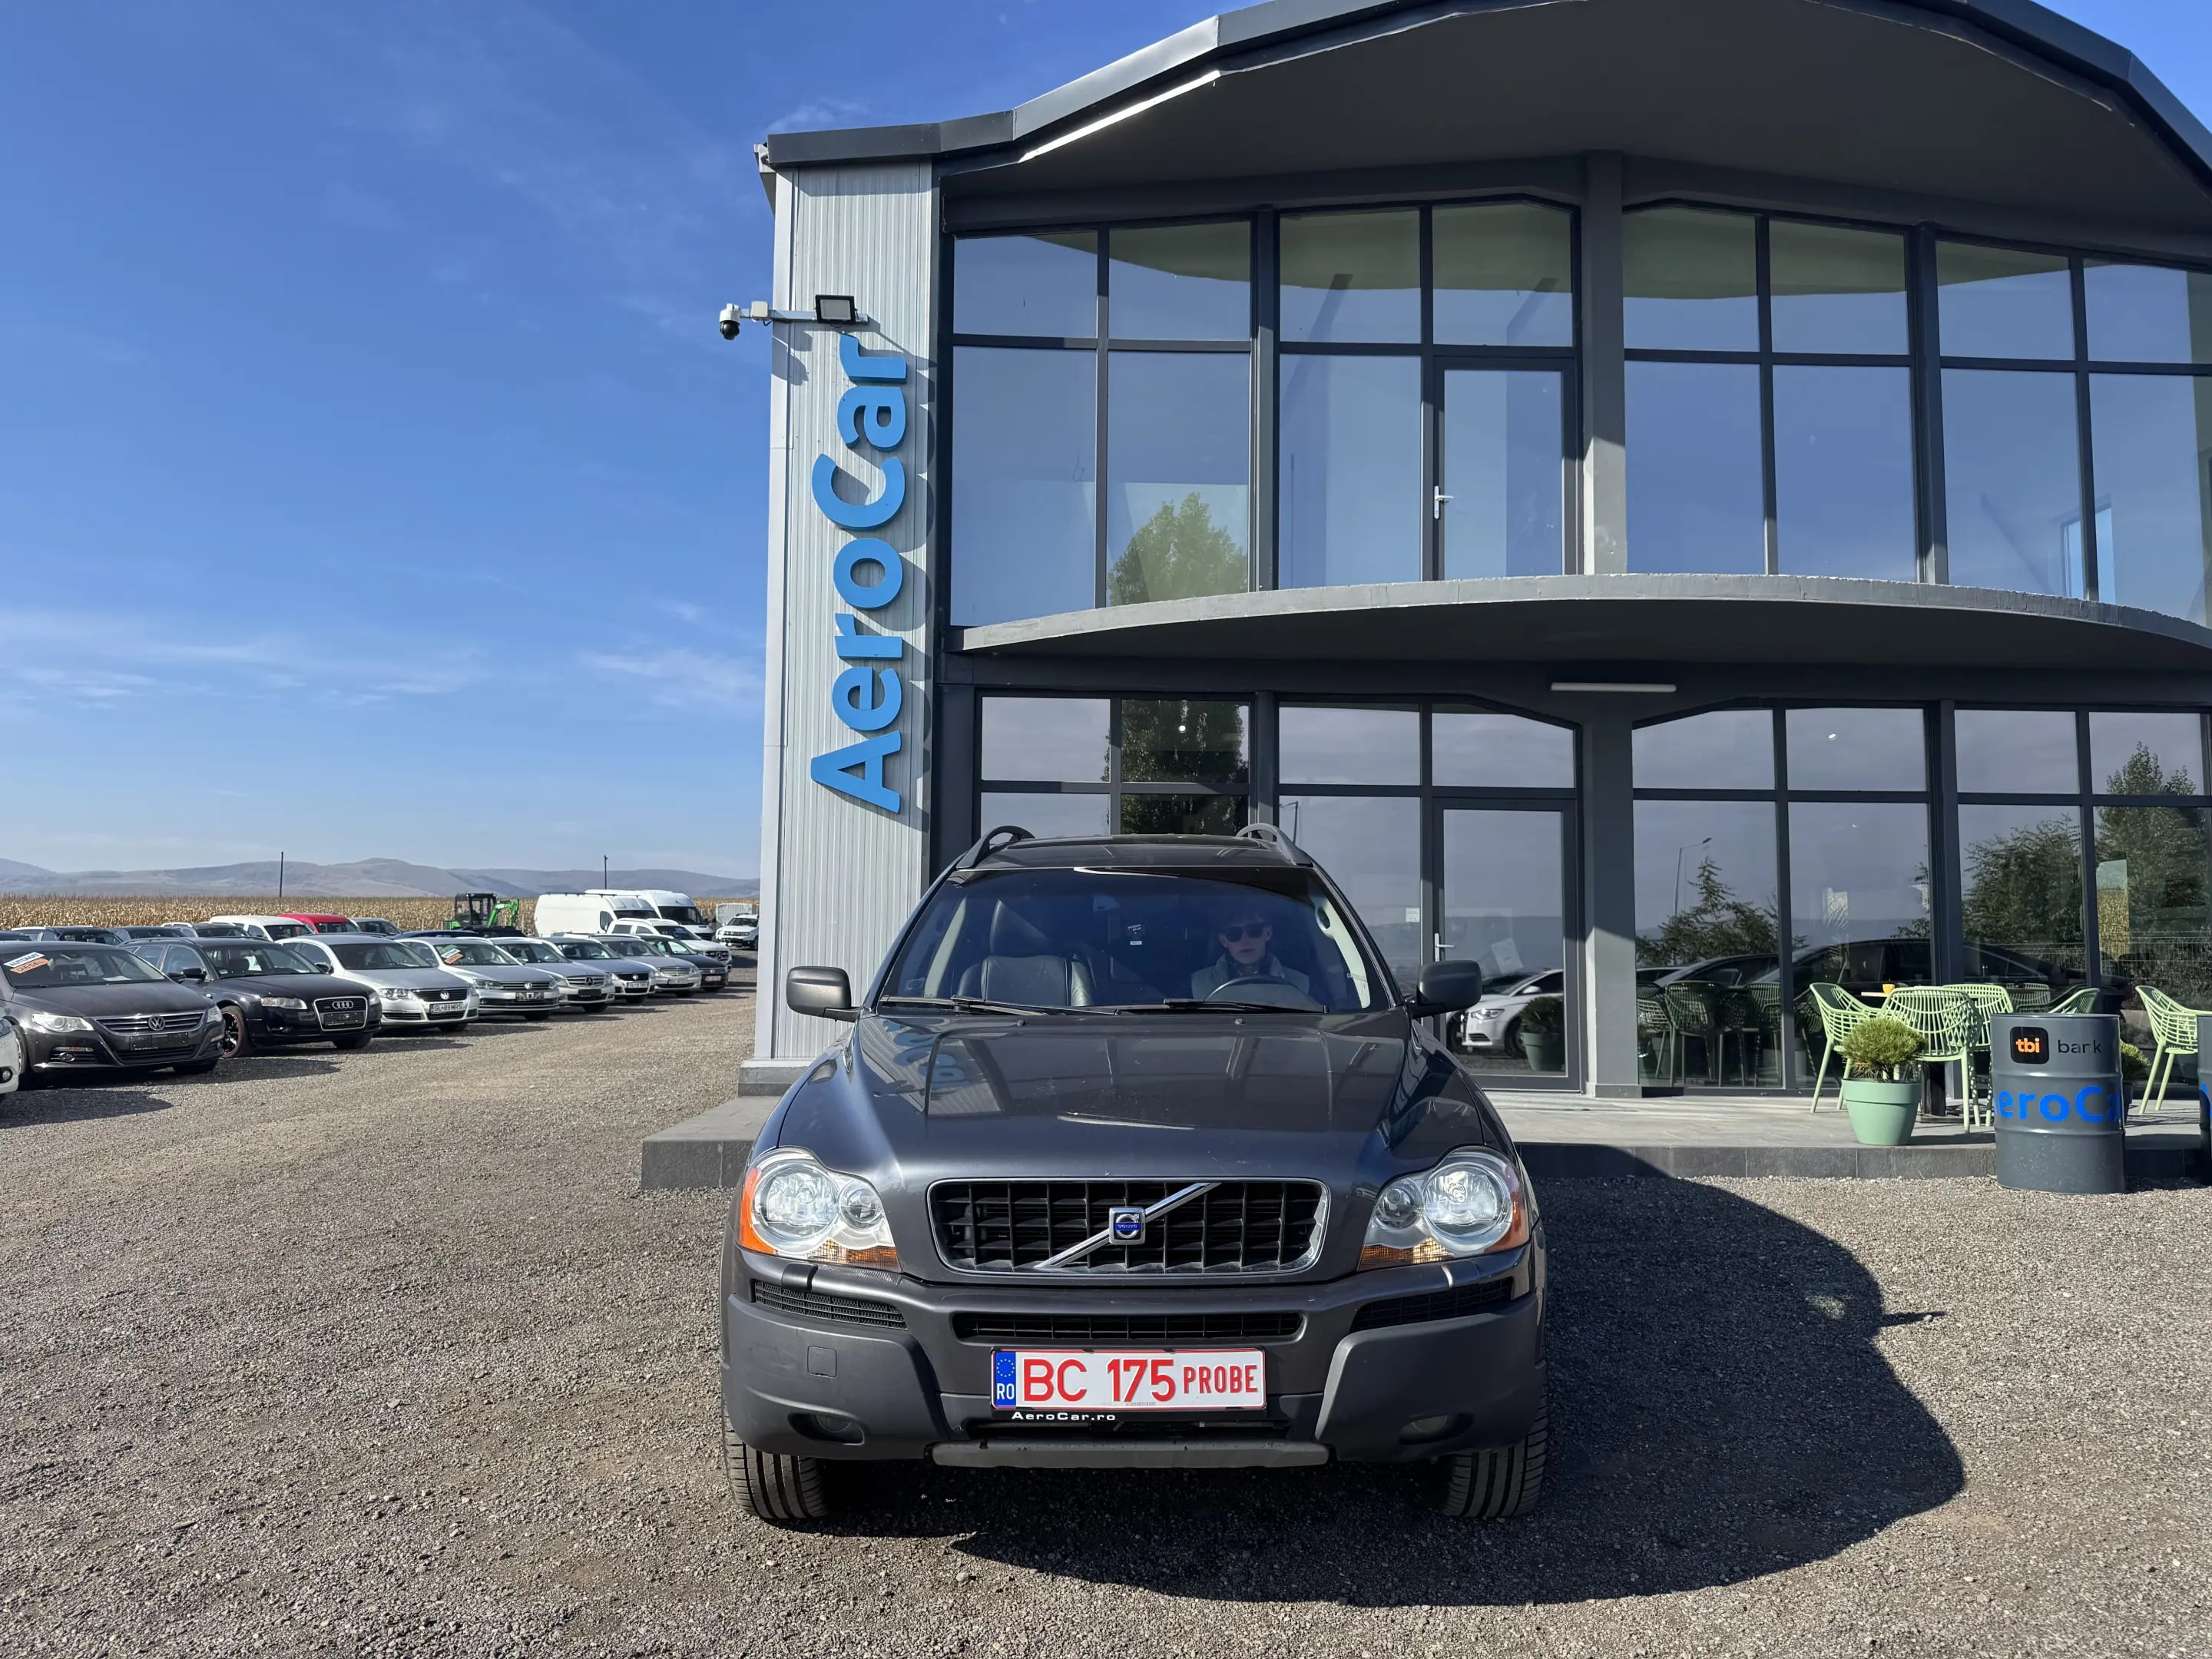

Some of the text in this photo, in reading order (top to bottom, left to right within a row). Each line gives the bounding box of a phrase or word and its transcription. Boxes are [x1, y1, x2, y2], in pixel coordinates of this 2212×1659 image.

[810, 333, 907, 813] AeroCar
[2015, 1038, 2040, 1053] tbi
[1024, 1358, 1258, 1402] BC 175 PROBE
[996, 1383, 1015, 1400] RO
[1011, 1412, 1116, 1421] AeroCar.ro
